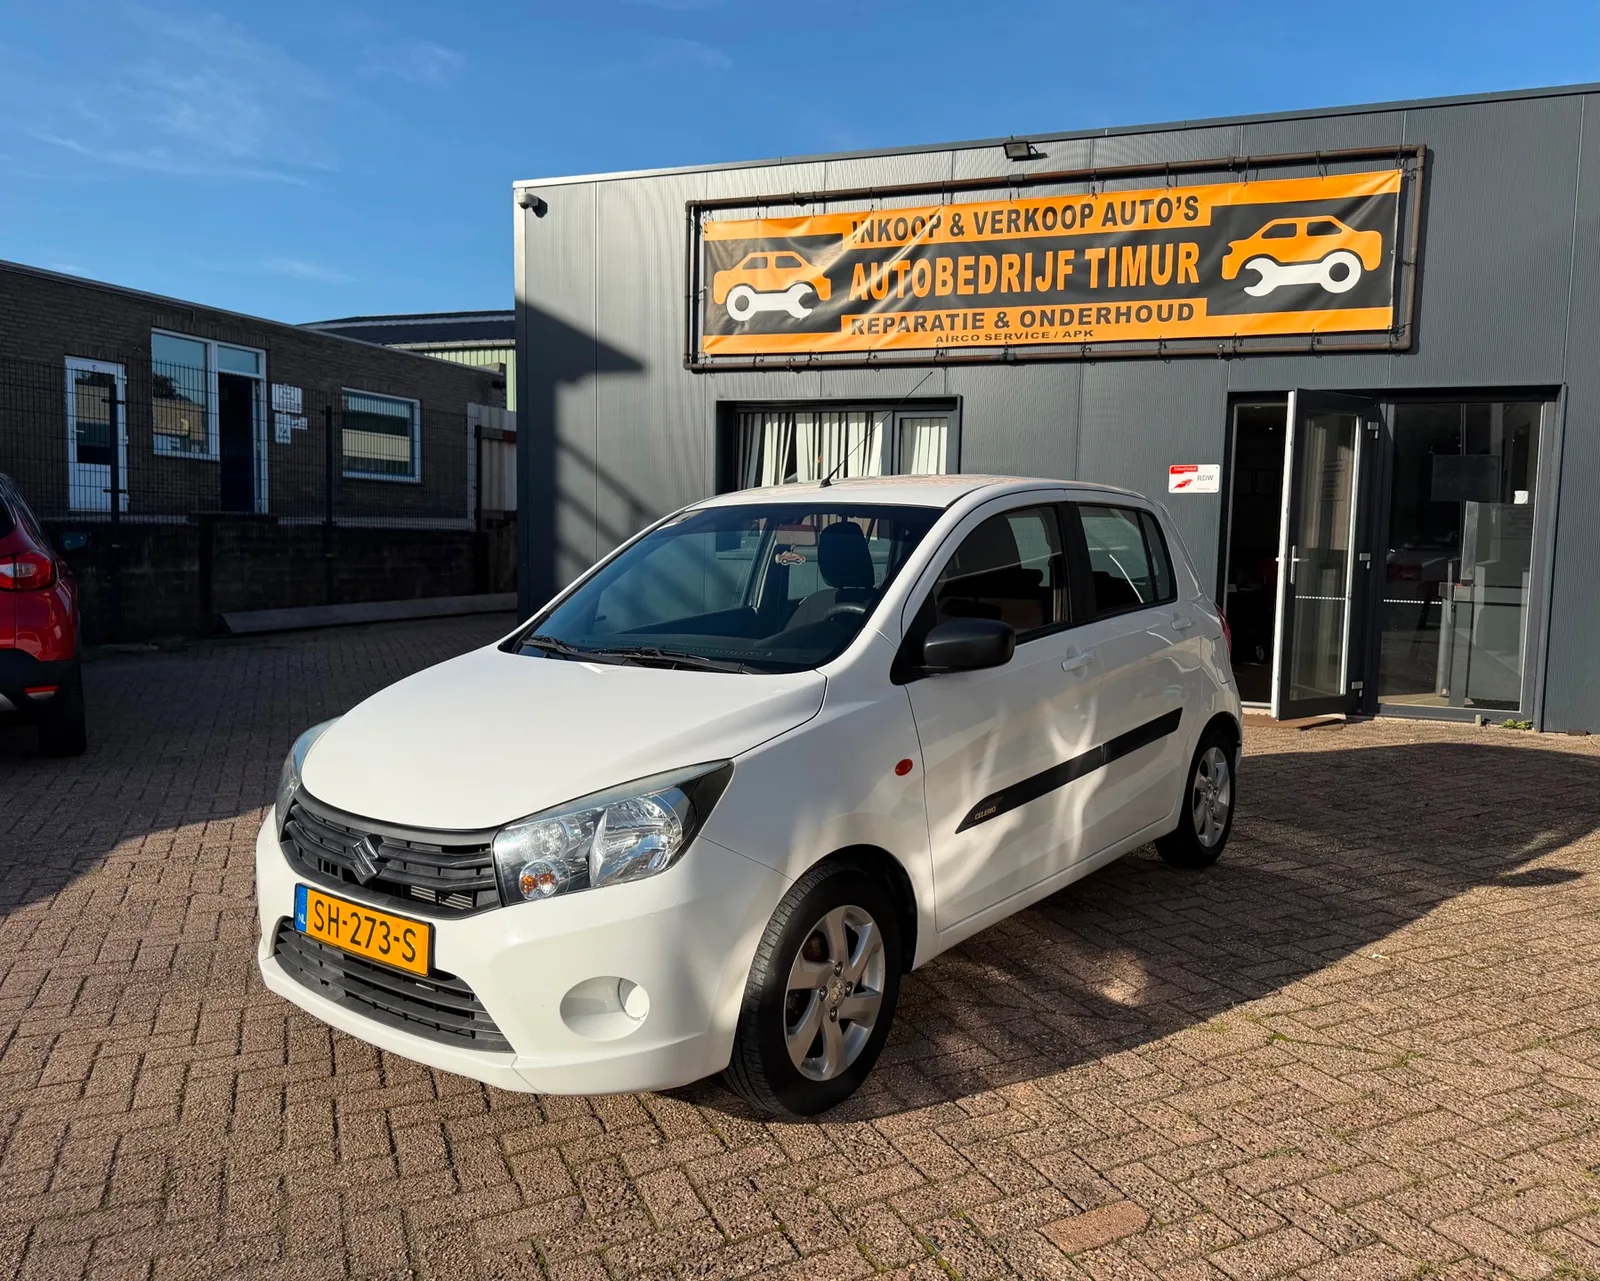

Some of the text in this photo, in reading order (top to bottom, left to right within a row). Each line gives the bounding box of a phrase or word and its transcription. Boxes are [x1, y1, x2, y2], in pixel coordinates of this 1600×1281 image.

[852, 195, 1199, 243] INKOOP & VERKOOP AUTO'S
[849, 242, 1200, 301] AUTOBEDRIJF TIMUR
[851, 303, 1194, 335] REPARATIE & ONDERHOUD
[1062, 329, 1094, 339] APK
[314, 900, 416, 963] SH-273-S
